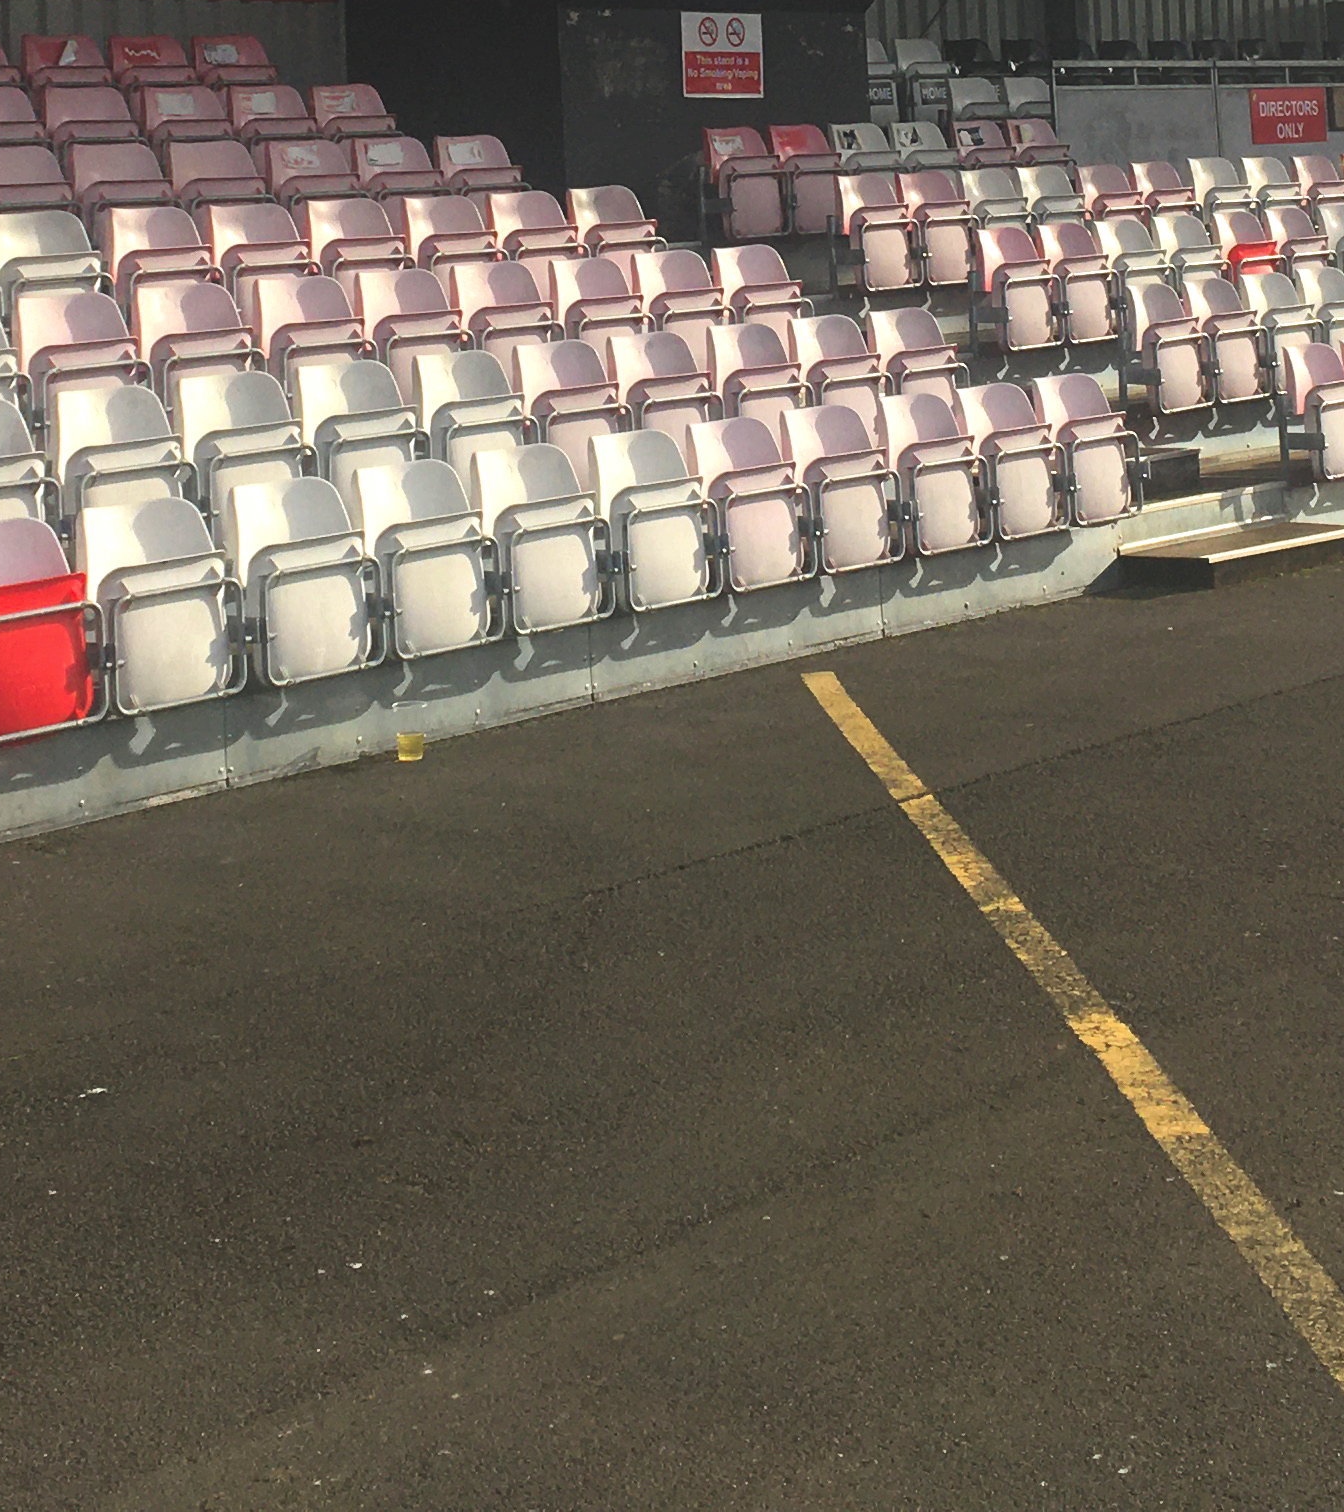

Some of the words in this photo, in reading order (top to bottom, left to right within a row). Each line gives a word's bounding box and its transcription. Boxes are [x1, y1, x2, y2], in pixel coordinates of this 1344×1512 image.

[921, 86, 948, 100] HOME
[1258, 100, 1319, 117] DIRECTORS
[1276, 122, 1304, 139] ONLY
